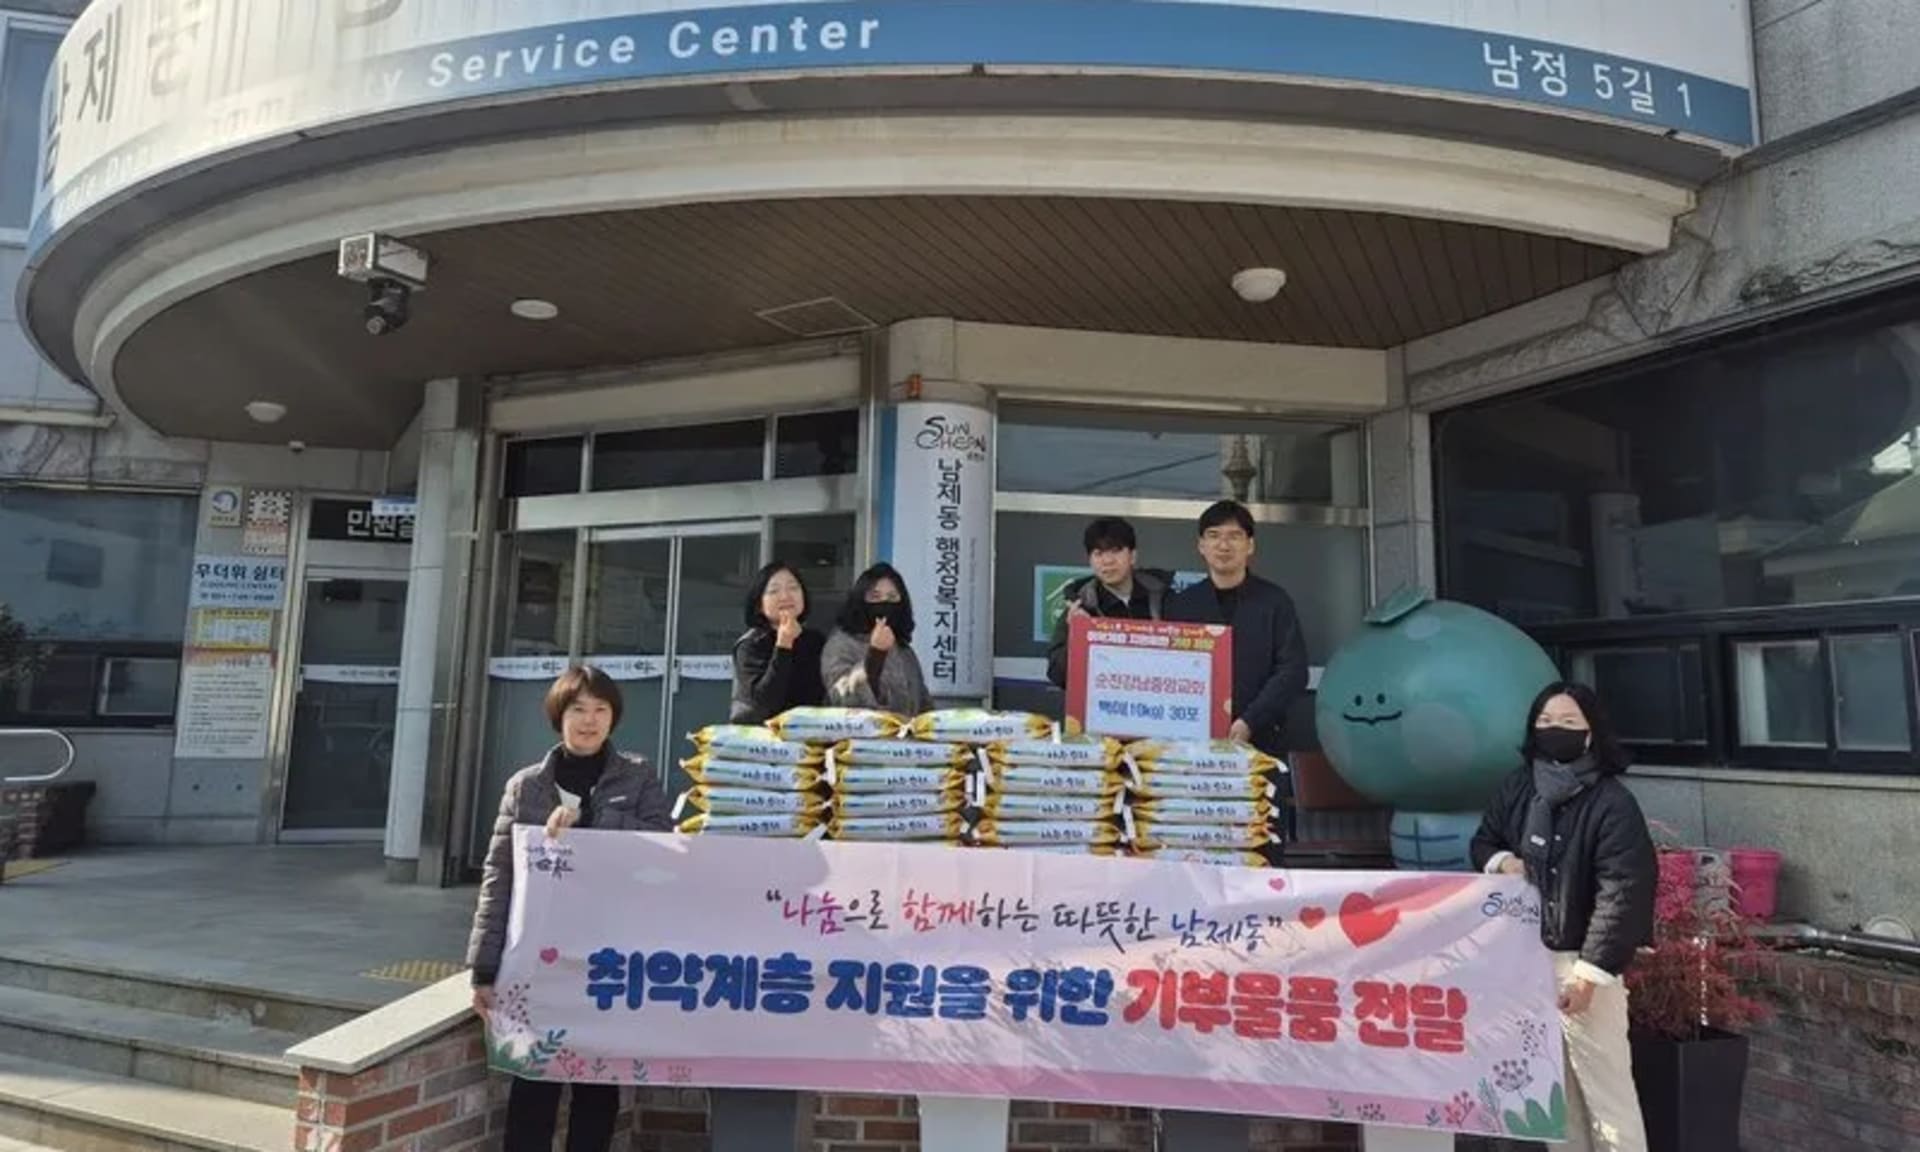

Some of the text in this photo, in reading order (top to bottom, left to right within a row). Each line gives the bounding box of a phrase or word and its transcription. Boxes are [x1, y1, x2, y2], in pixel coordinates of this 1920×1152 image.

[428, 15, 880, 87] Service Center
[1483, 42, 1691, 117] 남정 5길 1
[195, 562, 248, 579] 무더위
[932, 458, 963, 684] 남제동 행정복지센터
[901, 887, 1039, 932] 함께하는
[1052, 900, 1159, 954] 따뜻한
[587, 946, 1468, 1053] 취약계층 지원을 위한 기부물품 전달
